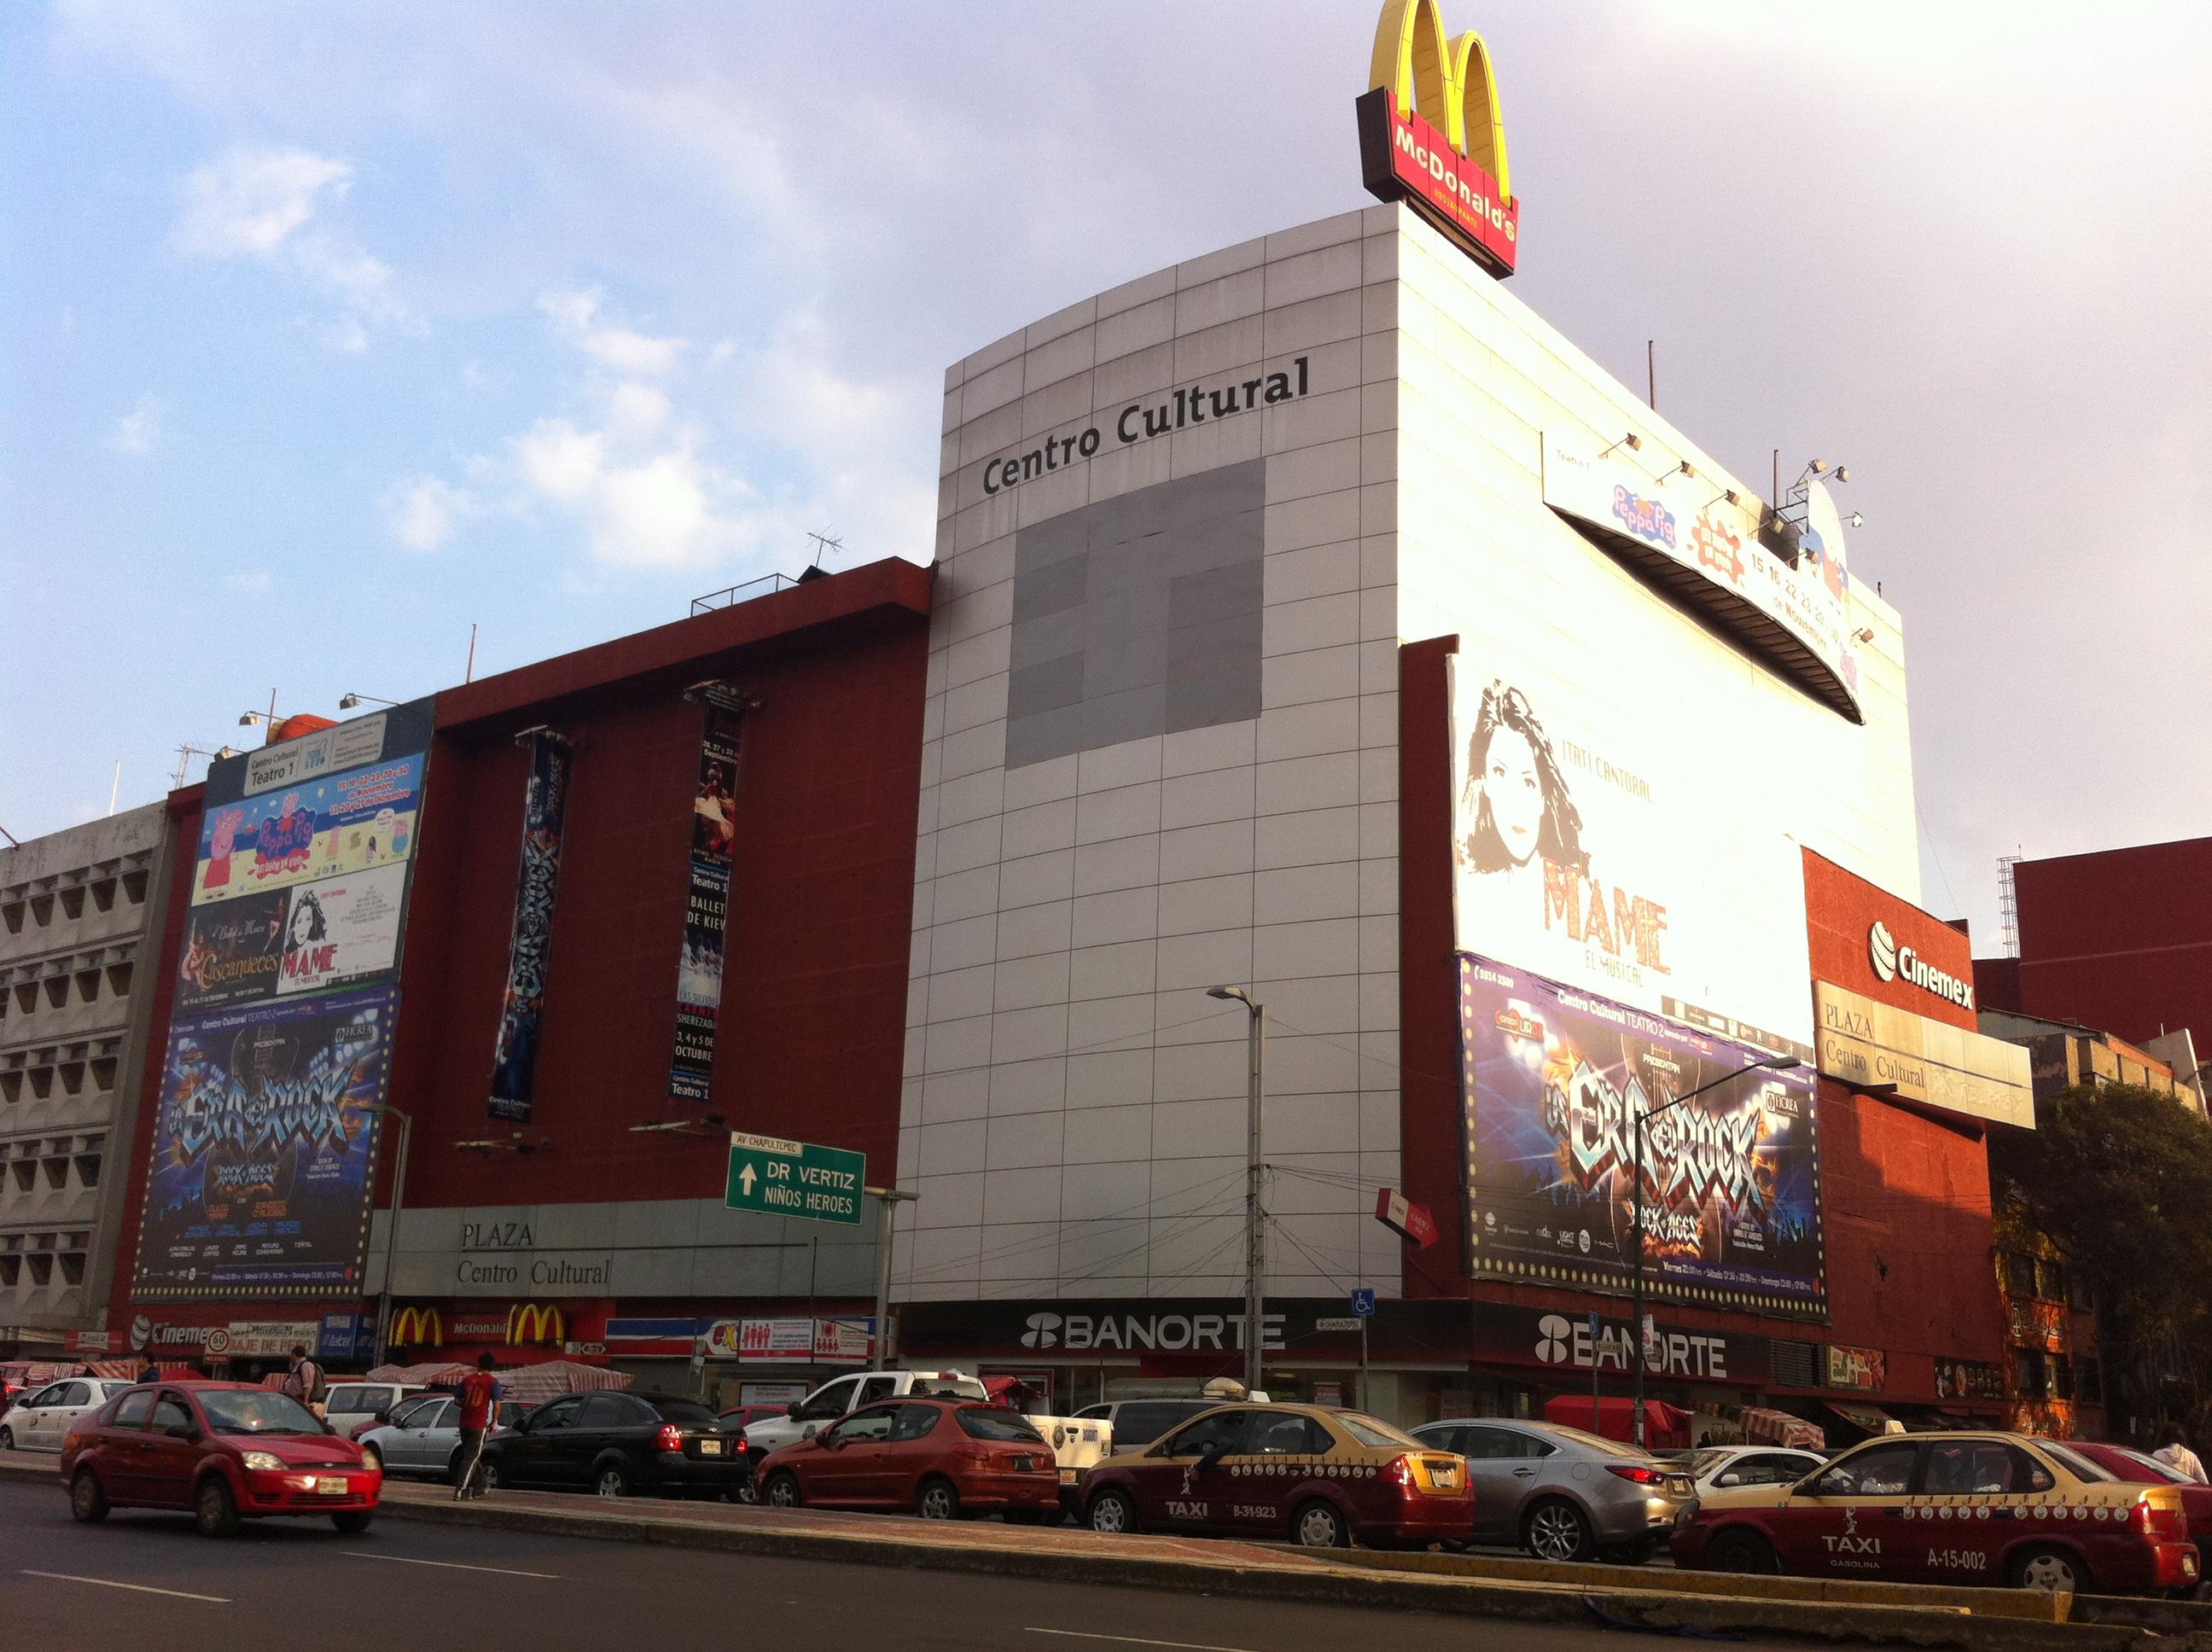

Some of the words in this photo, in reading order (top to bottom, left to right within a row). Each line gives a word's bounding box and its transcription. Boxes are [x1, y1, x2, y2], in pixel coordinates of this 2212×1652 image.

[1395, 125, 1516, 242] McDonald's
[983, 428, 1100, 495] Centro
[1117, 356, 1309, 444] Cultural
[1614, 485, 1655, 533] Peppa
[1654, 505, 1676, 548] Pig
[251, 756, 272, 770] Centro
[273, 747, 299, 763] Cultural
[251, 767, 286, 786] Teatro
[288, 762, 294, 776] 1
[1596, 757, 1653, 804] CANTORAL
[261, 819, 293, 855] Peppa
[297, 811, 312, 843] Pig
[692, 874, 720, 890] Teatro
[722, 882, 727, 893] 1
[690, 895, 726, 915] BALLET
[1543, 856, 1672, 977] MAME
[687, 910, 700, 926] DE
[704, 915, 726, 932] KIEV
[283, 944, 338, 978] MAME
[1599, 955, 1644, 988] MUSICAL
[1897, 945, 1974, 1011] Cinemex
[201, 1019, 222, 1031] Centro
[247, 1009, 271, 1023] TEATRO
[1557, 990, 1589, 1011] Centro
[1590, 1000, 1625, 1026] Cultural
[1626, 1014, 1658, 1036] TEATRO
[1657, 1023, 1665, 1038] 2
[1825, 1003, 1875, 1040] PLAZA
[685, 1032, 690, 1043] 4
[692, 1036, 697, 1046] y
[699, 1035, 704, 1045] 5
[705, 1036, 714, 1048] DE
[675, 1044, 713, 1062] OCTUBRE
[1825, 1038, 1867, 1073] Centro
[1877, 1055, 1925, 1090] Cultural
[672, 1083, 701, 1098] Teatro
[703, 1088, 710, 1099] 1
[183, 1080, 247, 1156] ERA
[251, 1058, 358, 1155] ROCK
[736, 1134, 747, 1143] AV
[748, 1137, 796, 1152] CHAPULTEPEC
[1569, 1060, 1660, 1193] ERA
[1664, 1084, 1764, 1209] ROCK
[768, 1160, 791, 1181] DR
[799, 1166, 855, 1190] VERTIZ
[765, 1184, 802, 1208] NIÑOS
[806, 1192, 853, 1215] HEROES
[462, 1223, 534, 1248] PLAZA
[1666, 1209, 1702, 1248] AGES
[457, 1259, 518, 1283] Centro
[532, 1259, 611, 1285] Cultural
[1663, 1260, 1682, 1274] Viernes
[152, 1322, 208, 1345] Cineme
[212, 1334, 225, 1345] 60
[260, 1337, 277, 1352] DE
[1065, 1314, 1286, 1350] BANORTE
[1165, 1501, 1208, 1516] TAXI
[1233, 1504, 1277, 1519] B-31-923
[1822, 1536, 1881, 1555] TAXI
[1831, 1559, 1880, 1569] GASOLINA
[1927, 1548, 1987, 1571] A-15-002
